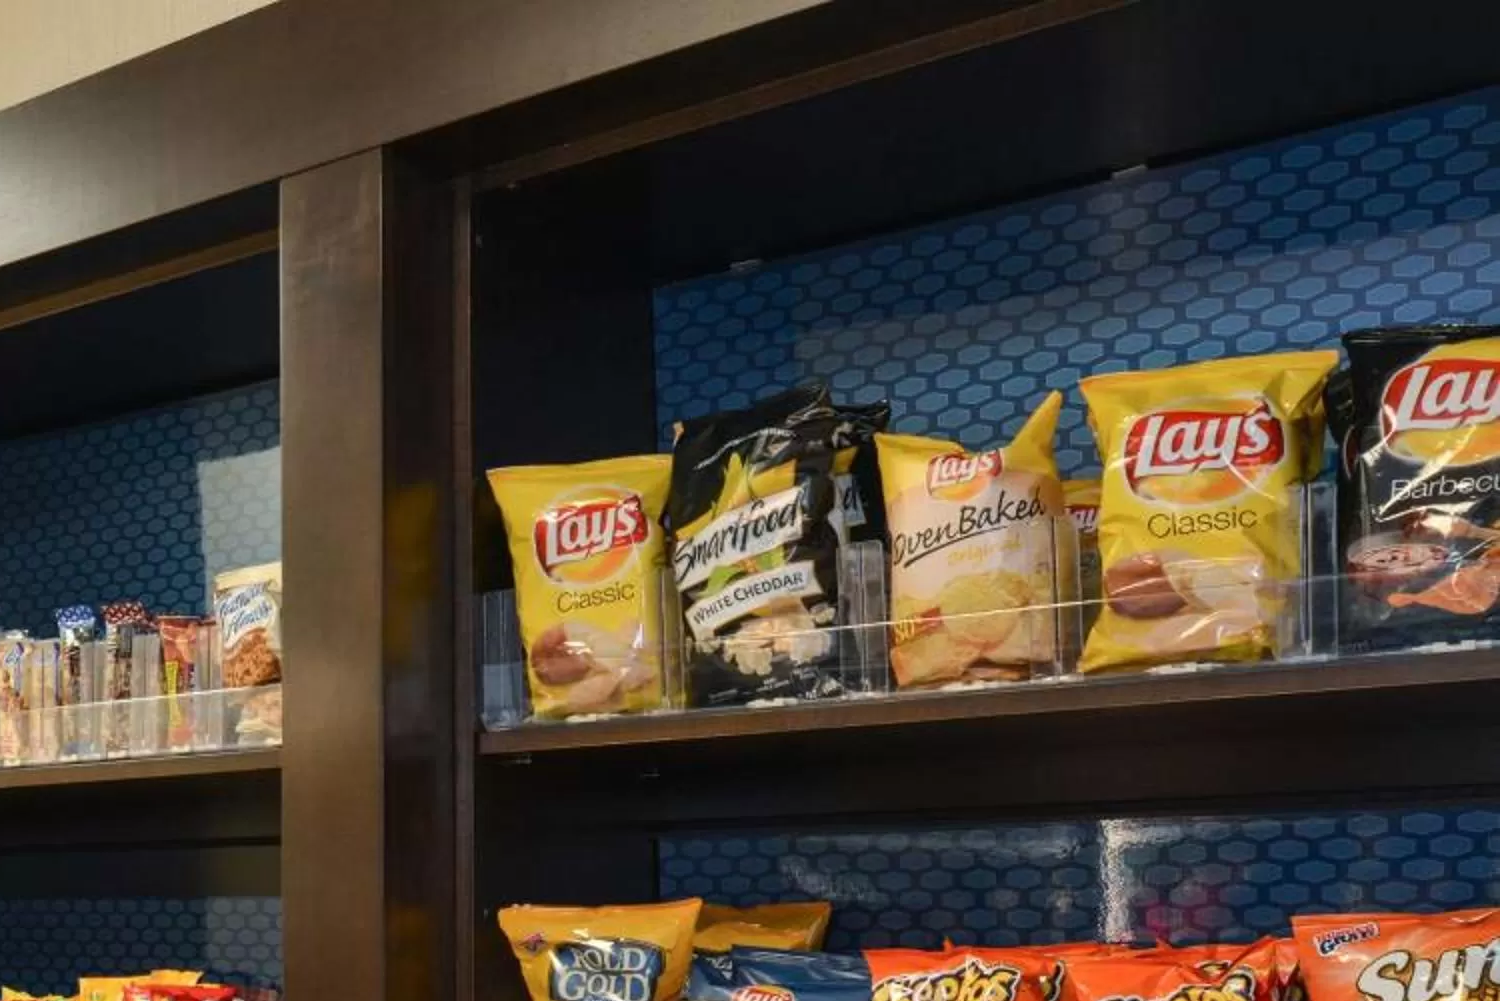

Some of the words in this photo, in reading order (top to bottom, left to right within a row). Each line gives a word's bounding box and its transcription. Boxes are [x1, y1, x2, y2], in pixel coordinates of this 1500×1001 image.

[931, 450, 999, 485] Lay's
[1133, 410, 1273, 478] Lay's
[544, 500, 641, 568] Lay's
[673, 494, 802, 583] Smartfood
[892, 522, 958, 566] Oven
[959, 486, 1046, 536] Baked
[1147, 505, 1258, 539] Classic
[556, 581, 636, 614] Classic
[693, 594, 733, 625] WHITE
[733, 570, 804, 602] CHEDDAR
